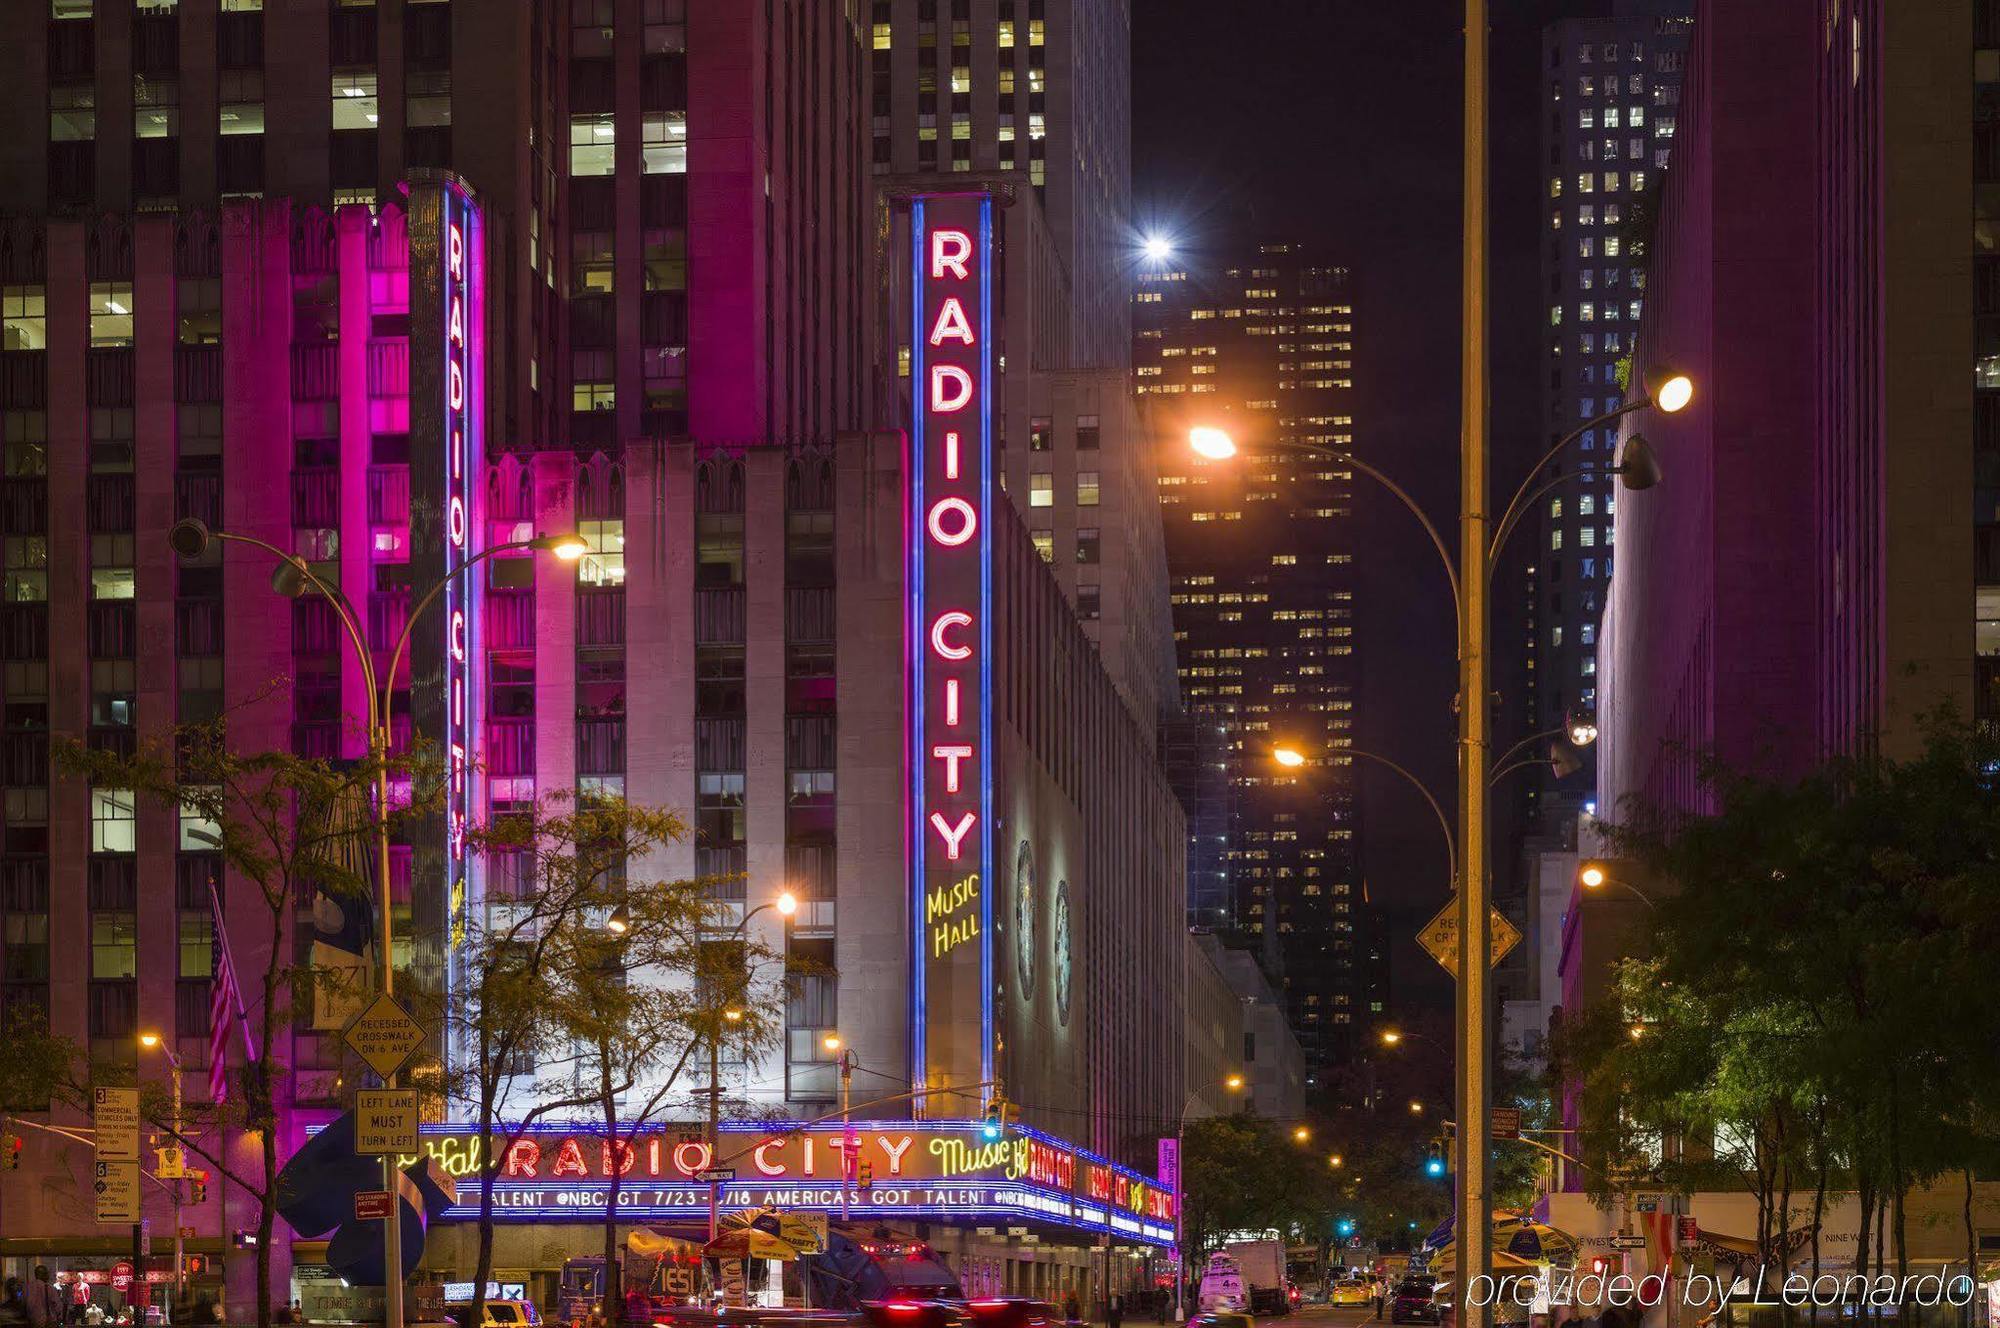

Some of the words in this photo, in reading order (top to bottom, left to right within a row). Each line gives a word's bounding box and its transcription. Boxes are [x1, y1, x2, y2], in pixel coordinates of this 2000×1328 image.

[450, 223, 464, 546] RADIO
[930, 231, 976, 546] RADIO
[931, 612, 976, 860] CITY
[360, 1018, 411, 1030] RECESSED
[356, 1031, 415, 1042] CROSSWALK
[362, 1044, 376, 1054] ON
[380, 1045, 386, 1053] 6
[391, 1043, 410, 1054] AVE
[360, 1097, 382, 1109] LEFT
[389, 1097, 413, 1109] LANE
[370, 1115, 404, 1129] MUST
[360, 1135, 386, 1147] TURN
[390, 1135, 414, 1147] LEFT
[508, 1137, 713, 1178] RADIO
[753, 1136, 913, 1176] CITY
[929, 1138, 1010, 1177] Music
[872, 1190, 911, 1206] GOT
[925, 1190, 987, 1205] TALENT
[1587, 1237, 1611, 1247] WEST
[1825, 1233, 1848, 1242] NINE
[1850, 1233, 1874, 1242] WT
